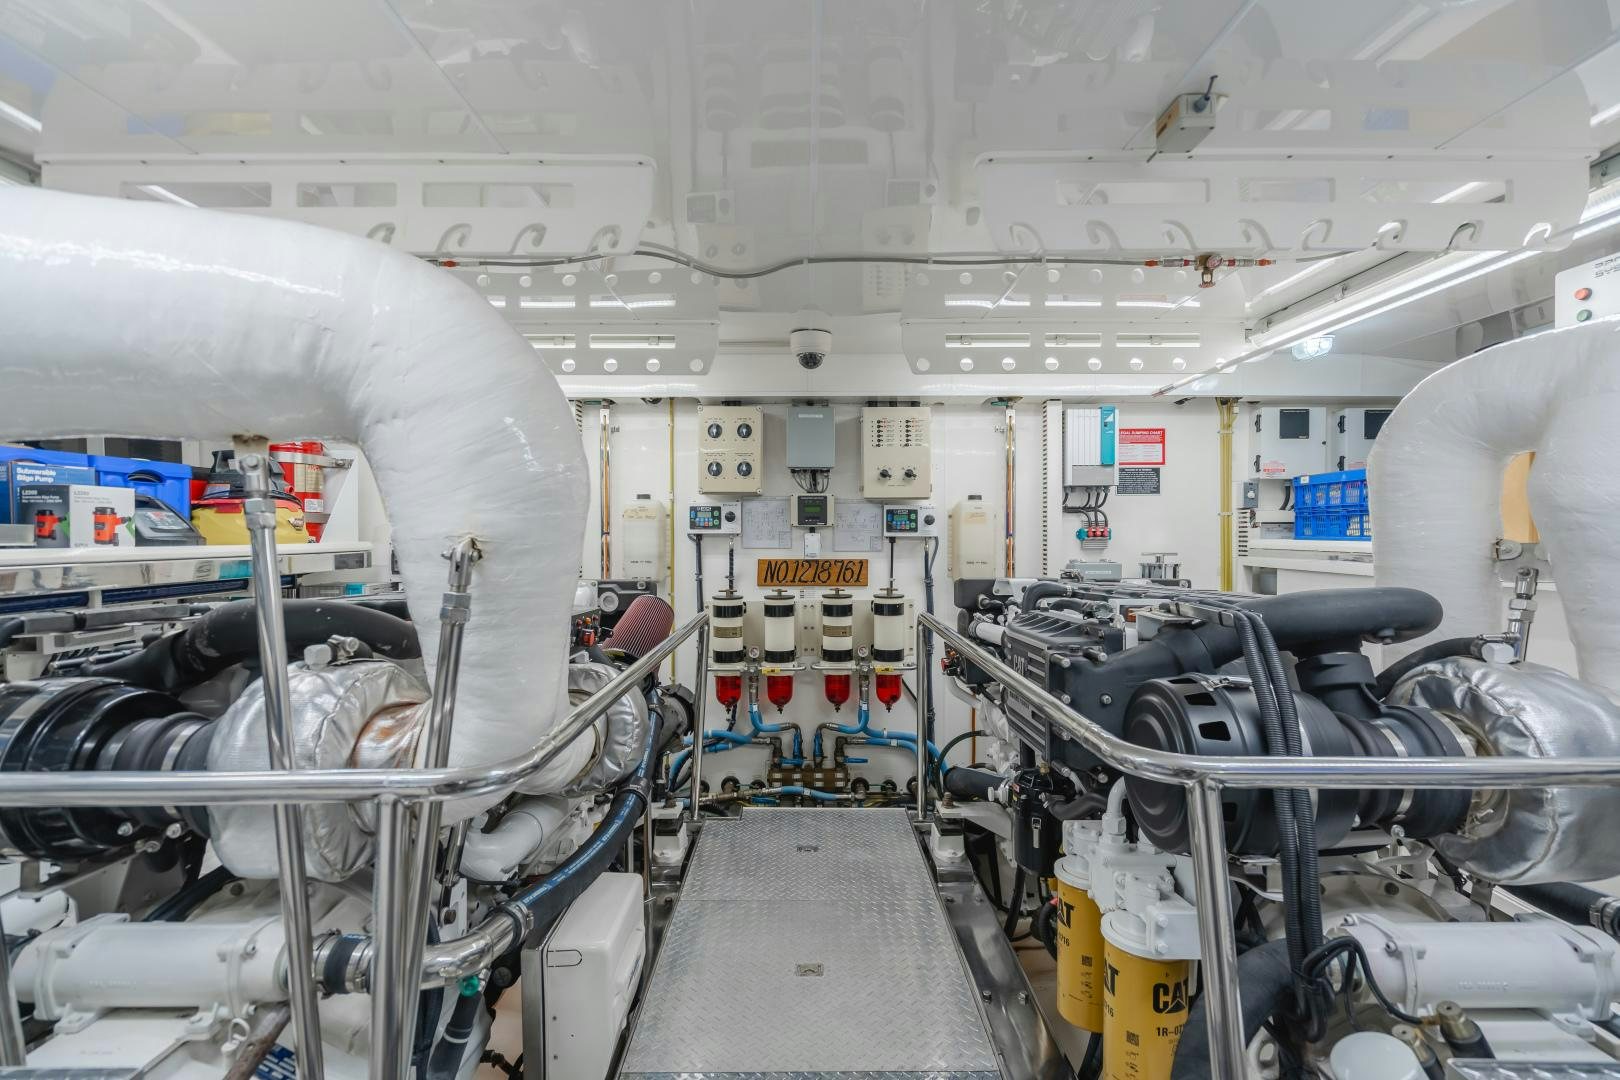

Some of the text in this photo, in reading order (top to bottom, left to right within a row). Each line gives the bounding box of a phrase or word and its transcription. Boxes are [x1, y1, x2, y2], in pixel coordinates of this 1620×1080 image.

[35, 476, 54, 484] Pump
[1058, 897, 1075, 929] AT
[1104, 957, 1120, 997] AT
